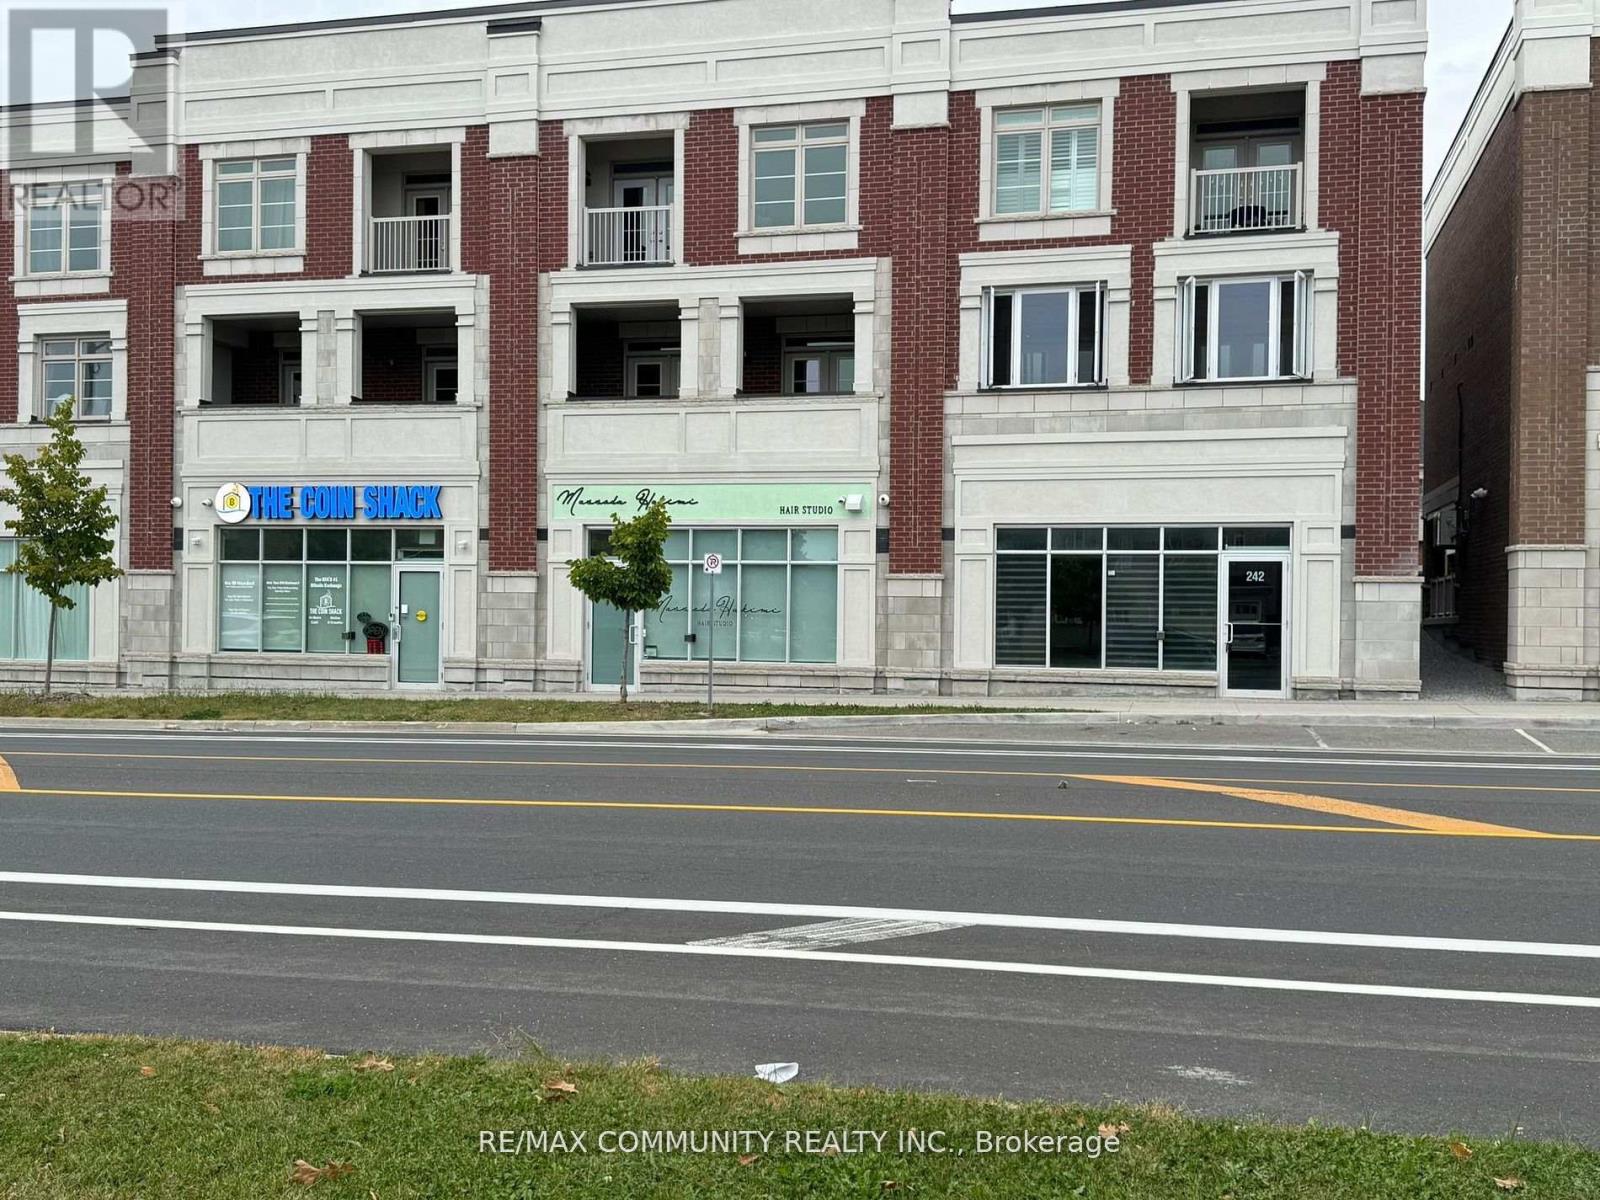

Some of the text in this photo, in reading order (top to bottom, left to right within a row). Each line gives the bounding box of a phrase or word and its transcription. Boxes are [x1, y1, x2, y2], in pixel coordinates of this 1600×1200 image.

[248, 485, 443, 520] THE COIN SHACK
[779, 505, 833, 515] HAIR STUDIO
[1246, 570, 1265, 582] 242
